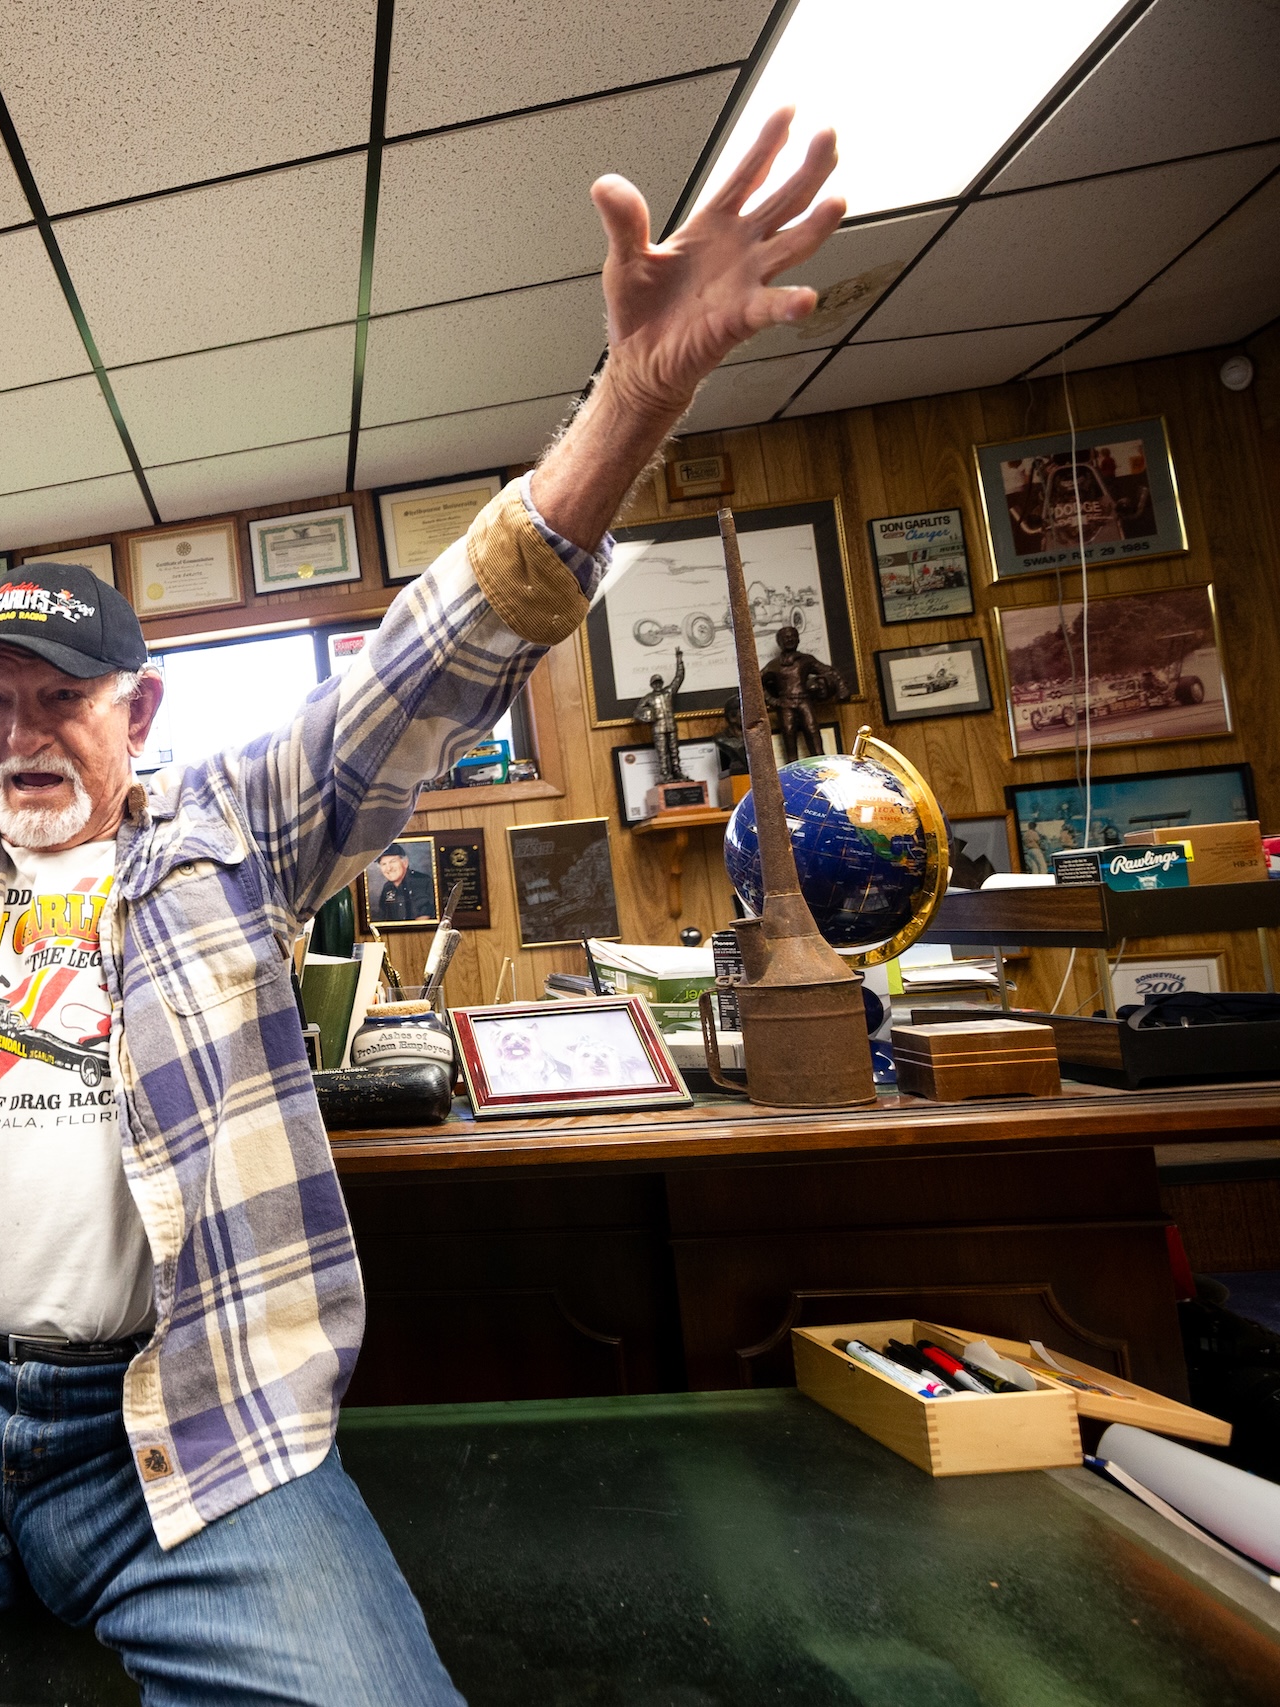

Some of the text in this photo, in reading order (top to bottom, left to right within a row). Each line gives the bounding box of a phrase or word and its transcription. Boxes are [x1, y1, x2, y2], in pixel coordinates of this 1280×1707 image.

[880, 516, 951, 533] DON GARLITS
[905, 529, 951, 542] Charger
[1100, 547, 1115, 556] 29
[1121, 541, 1150, 553] 1985
[18, 611, 48, 623] RACING
[803, 809, 827, 820] OCEAN
[1110, 850, 1180, 876] Rawlings
[13, 893, 102, 957] GARLI
[68, 949, 103, 969] LEG
[1135, 972, 1186, 984] BONNEVILLE
[1136, 981, 1185, 994] 200
[379, 1031, 428, 1042] Ashes of
[357, 1040, 452, 1059] Problem Employees
[9, 1093, 62, 1112] DRAG
[69, 1089, 116, 1108] RAC
[56, 1110, 118, 1127] FLORI
